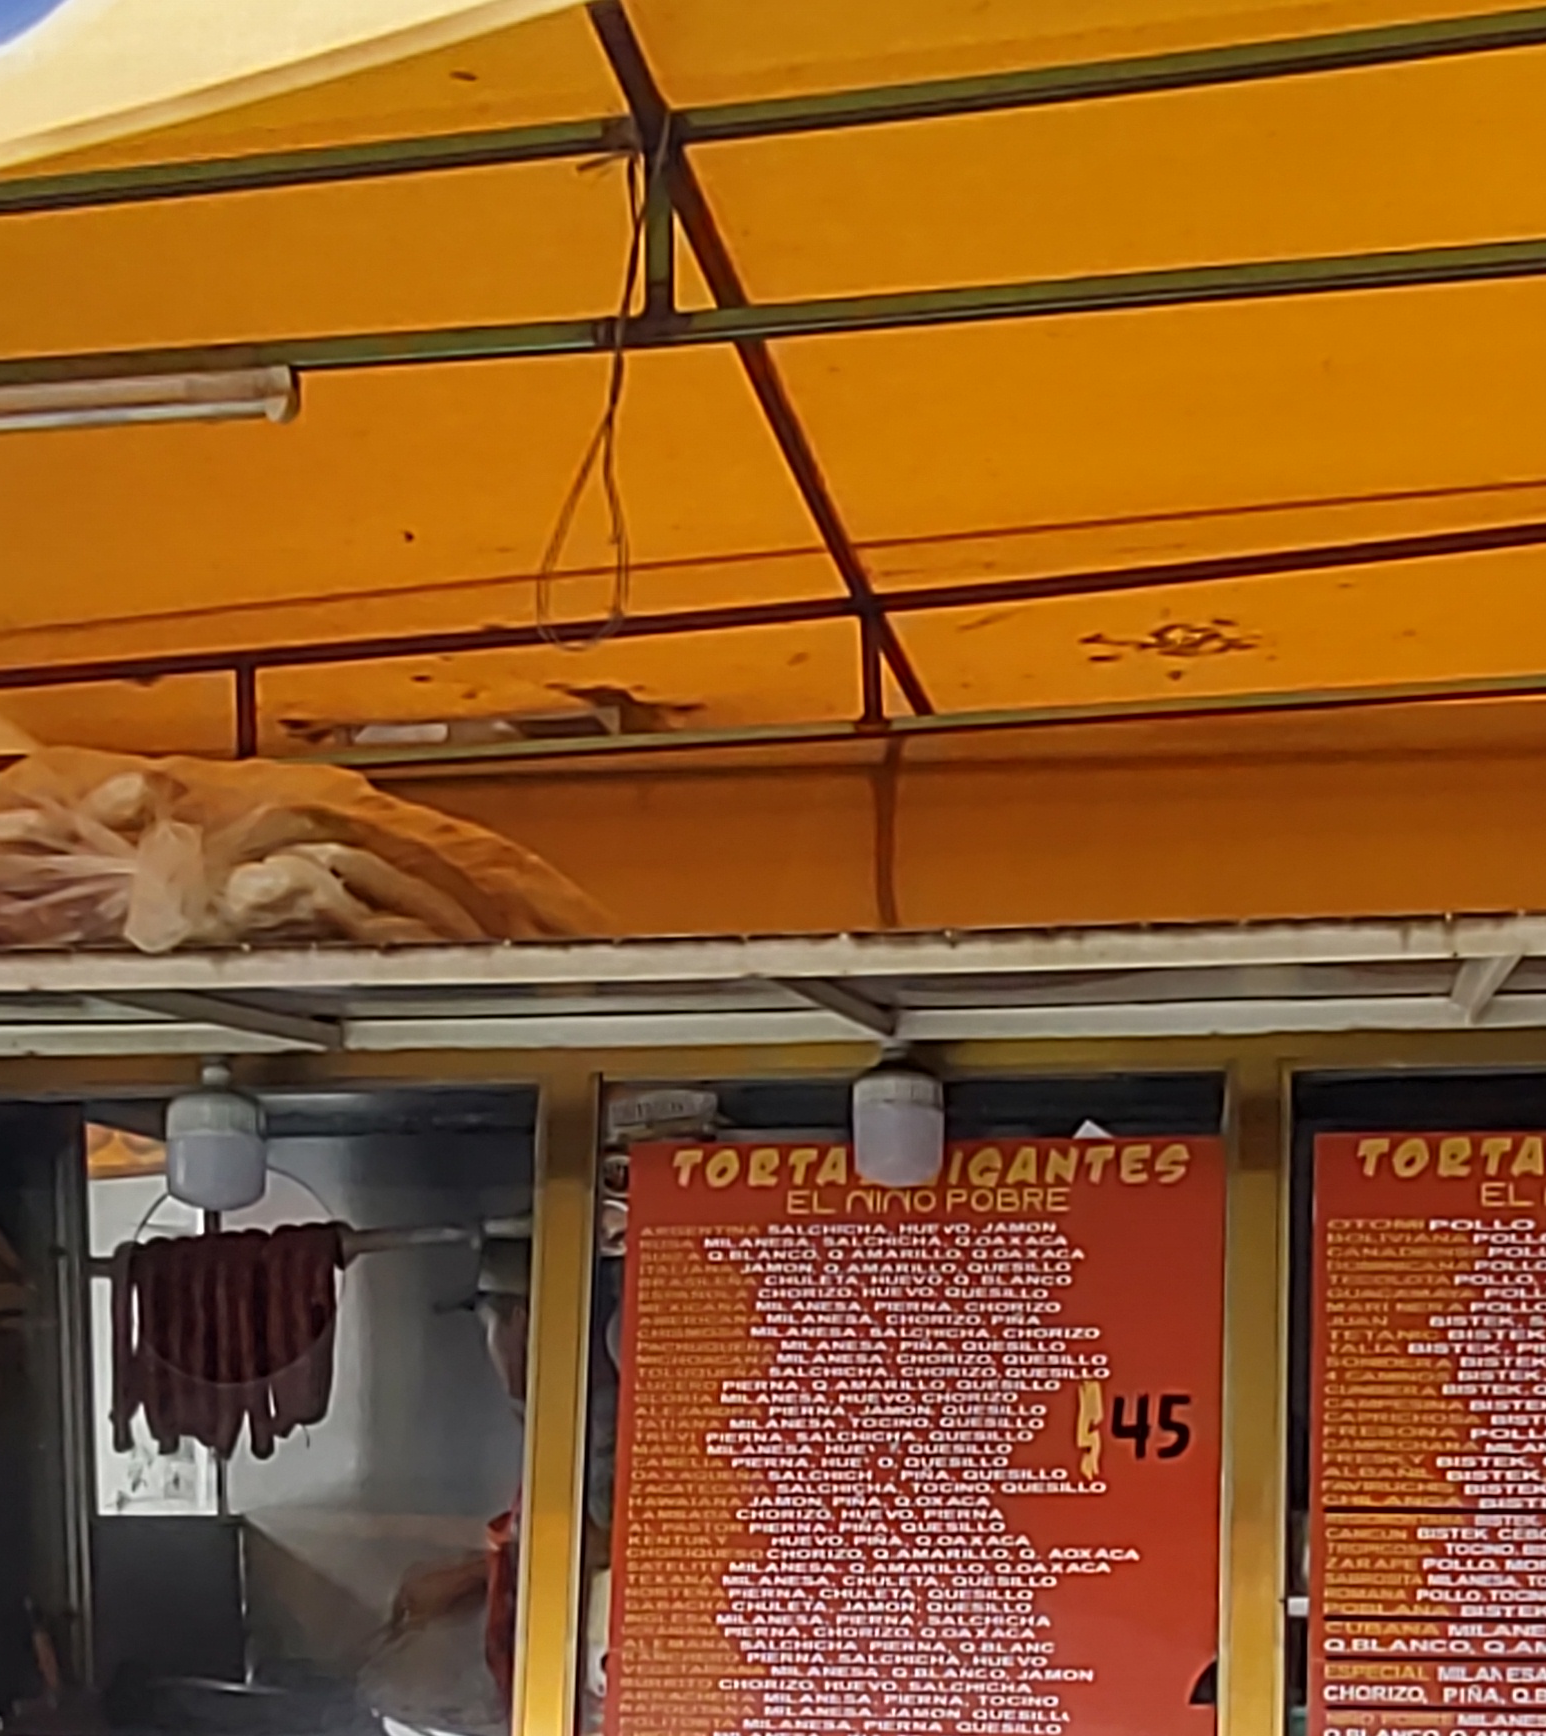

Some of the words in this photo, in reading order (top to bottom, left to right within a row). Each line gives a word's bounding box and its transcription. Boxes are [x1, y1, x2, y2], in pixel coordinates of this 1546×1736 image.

[672, 1146, 866, 1188] TORTA
[925, 1143, 1192, 1187] IGANTES
[786, 1189, 838, 1215] EL
[946, 1186, 1072, 1213] POBRE
[1480, 1182, 1535, 1207] EL
[981, 1221, 1057, 1234] JAMON
[966, 1261, 1072, 1274] QUESILLO
[944, 1287, 1049, 1300] QUESILLO
[963, 1301, 1061, 1313] CHORIZO
[1002, 1327, 1100, 1339] CHORIZO
[961, 1340, 1066, 1353] QUESILLO
[1002, 1353, 1108, 1366] QUESILLO
[1005, 1367, 1111, 1379] QUESILLO
[955, 1379, 1061, 1391] QUESILLO
[921, 1391, 1018, 1404] CHORIZO
[941, 1404, 1047, 1416] QUESILLO
[939, 1417, 1045, 1429] QUESILLO
[928, 1430, 1034, 1443] QUESILLO
[907, 1443, 1013, 1455] QUESILLO
[903, 1456, 1009, 1469] QUESILLO
[962, 1468, 1068, 1481] QUESILLO
[1000, 1481, 1107, 1494] QUESILLO
[923, 1508, 1004, 1520] PIERNA
[900, 1521, 1005, 1534] QUESILLO
[951, 1575, 1057, 1588] QUESILLO
[927, 1588, 1034, 1601] QUESILLO
[926, 1602, 1033, 1614] QUESILLO
[1323, 1620, 1440, 1636] CUBANA
[972, 1655, 1049, 1667] HUEVO
[1323, 1661, 1430, 1682] ESPECIAL
[978, 1694, 1060, 1707] TOCINO
